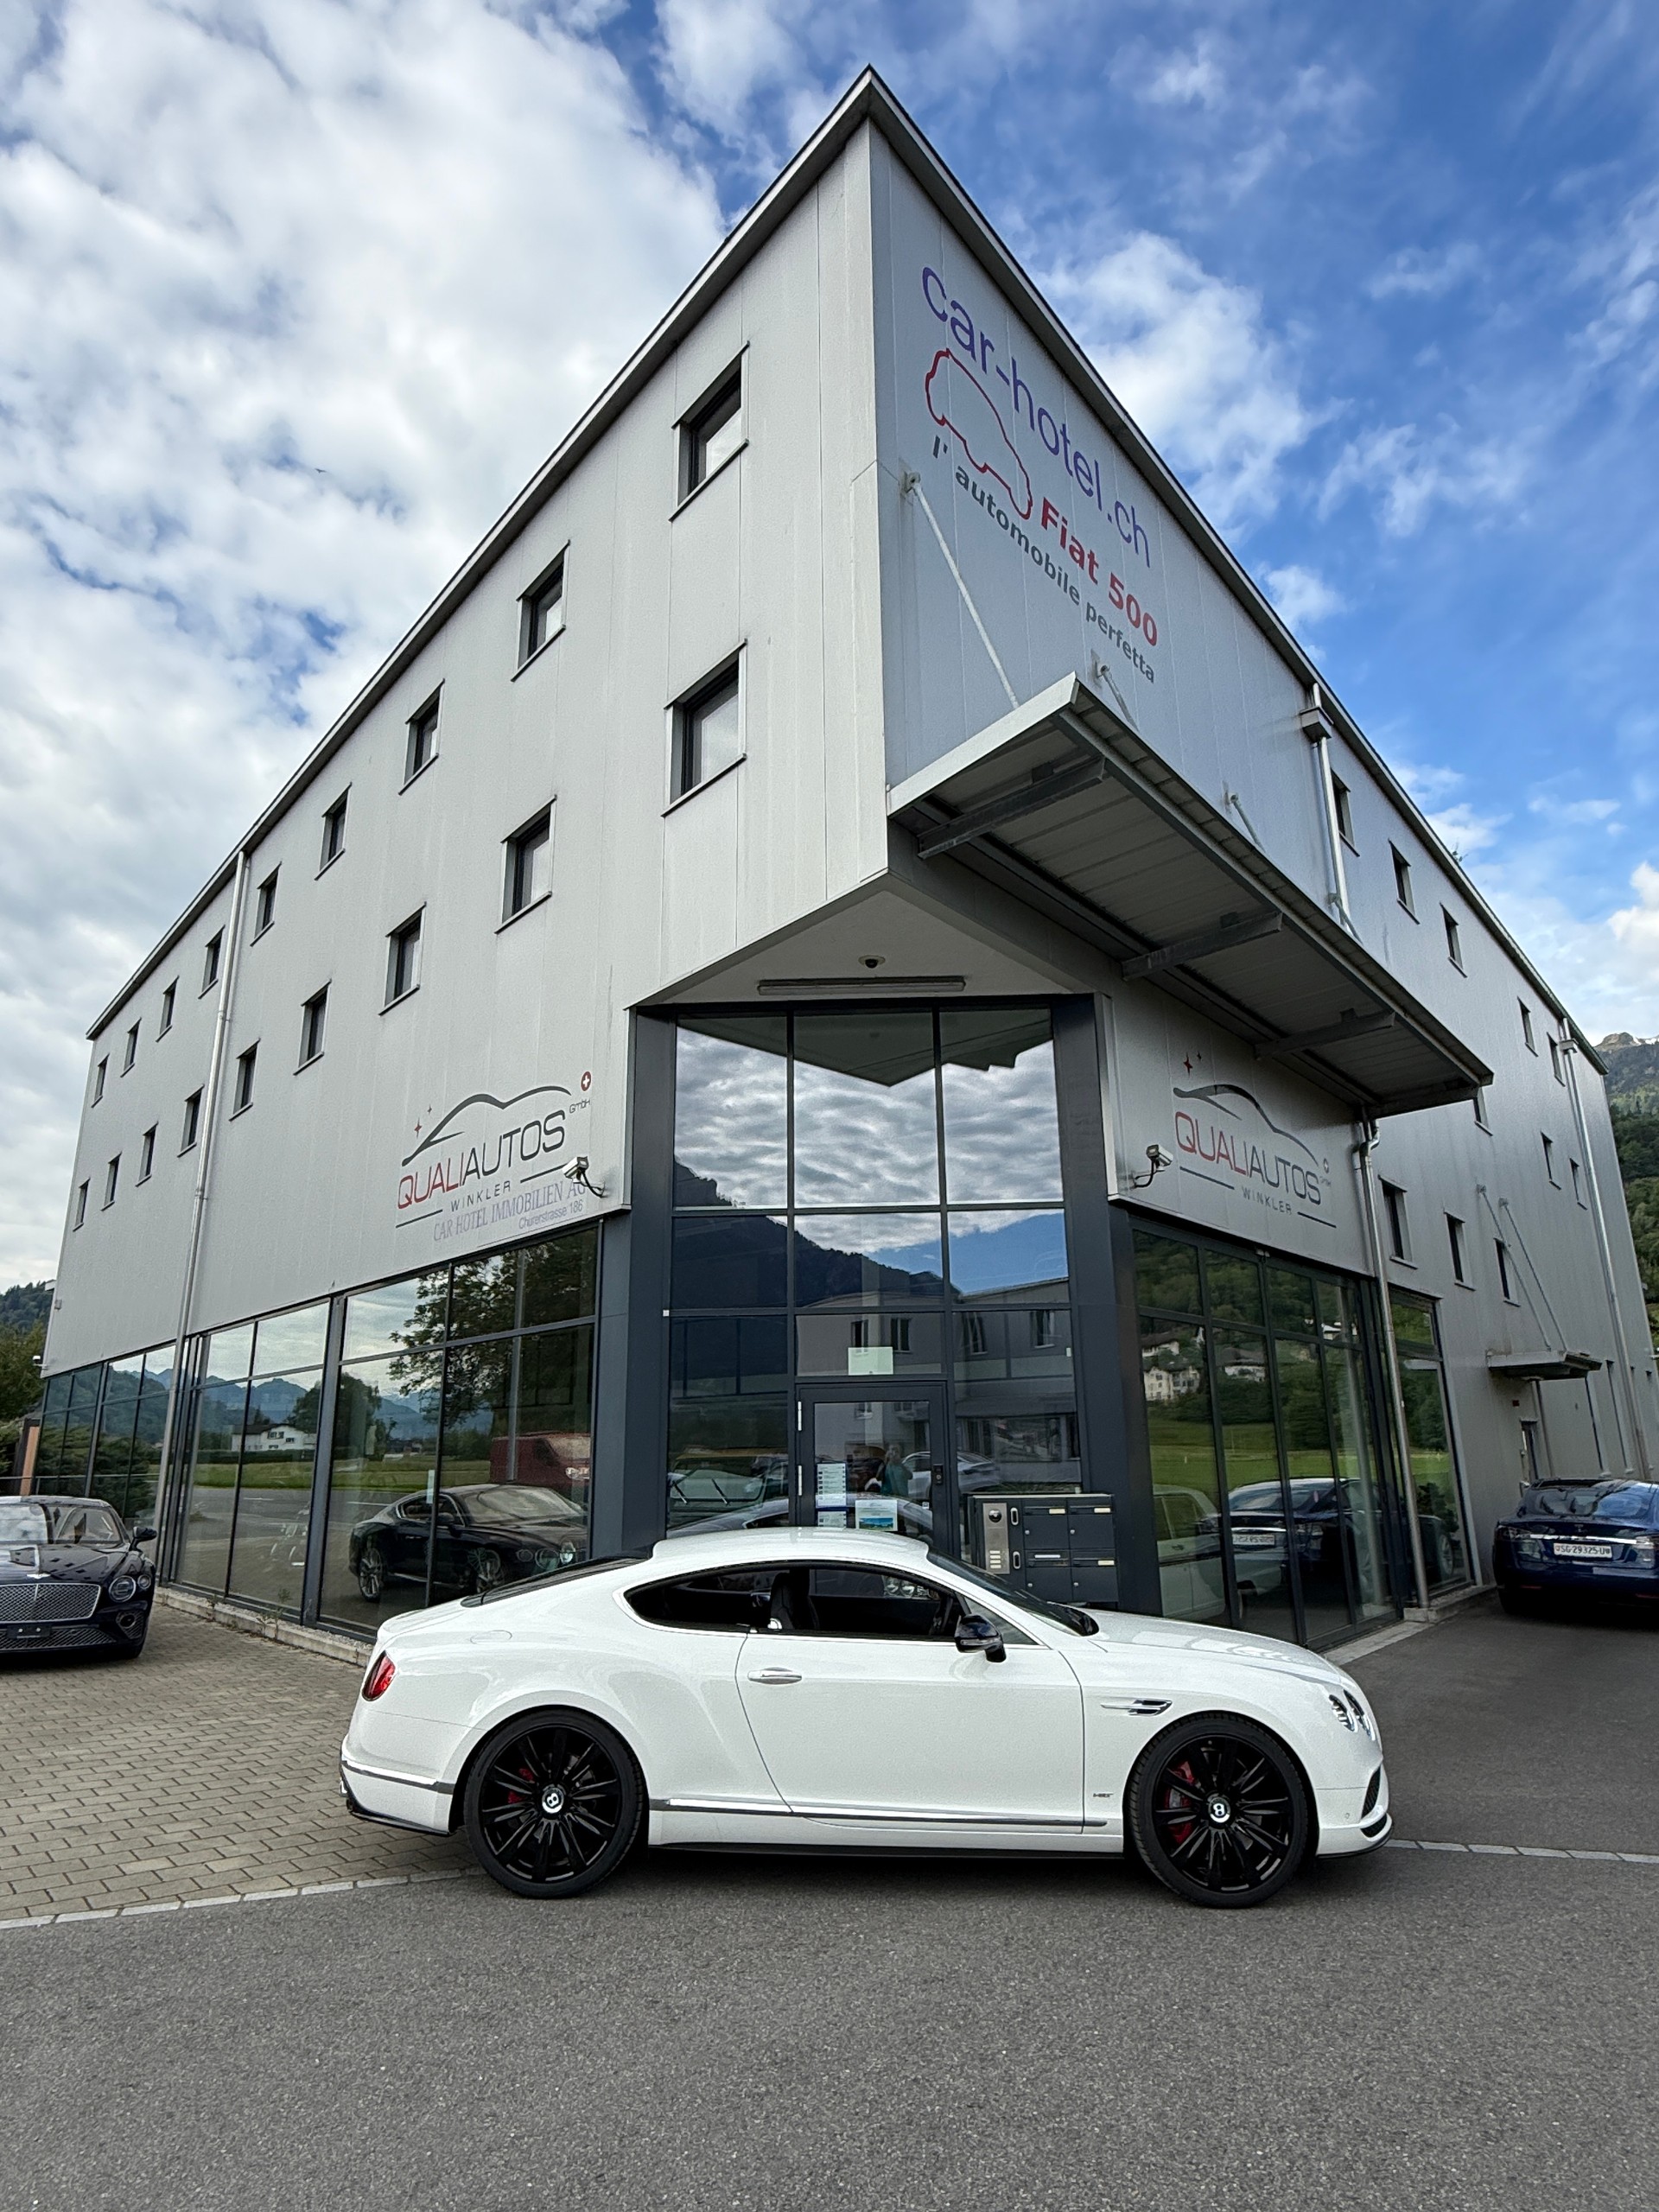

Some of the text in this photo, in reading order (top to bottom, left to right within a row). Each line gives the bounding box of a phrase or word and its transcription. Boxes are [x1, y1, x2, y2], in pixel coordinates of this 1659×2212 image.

[922, 267, 1151, 568] car-hotel.ch
[956, 465, 1081, 607] automobile
[1085, 601, 1154, 683] perfetta
[1041, 498, 1158, 646] Fiat 500
[398, 1110, 565, 1208] QUALIAUTOS
[450, 1180, 511, 1211] WINKLER
[1175, 1111, 1321, 1205] QUALIAUTOS
[1242, 1187, 1292, 1214] WINKLER
[433, 1219, 453, 1242] CAR
[455, 1206, 488, 1235] HOTEL
[491, 1180, 563, 1224] IMMOBILIEN
[518, 1199, 583, 1229] Churerstrasse 186
